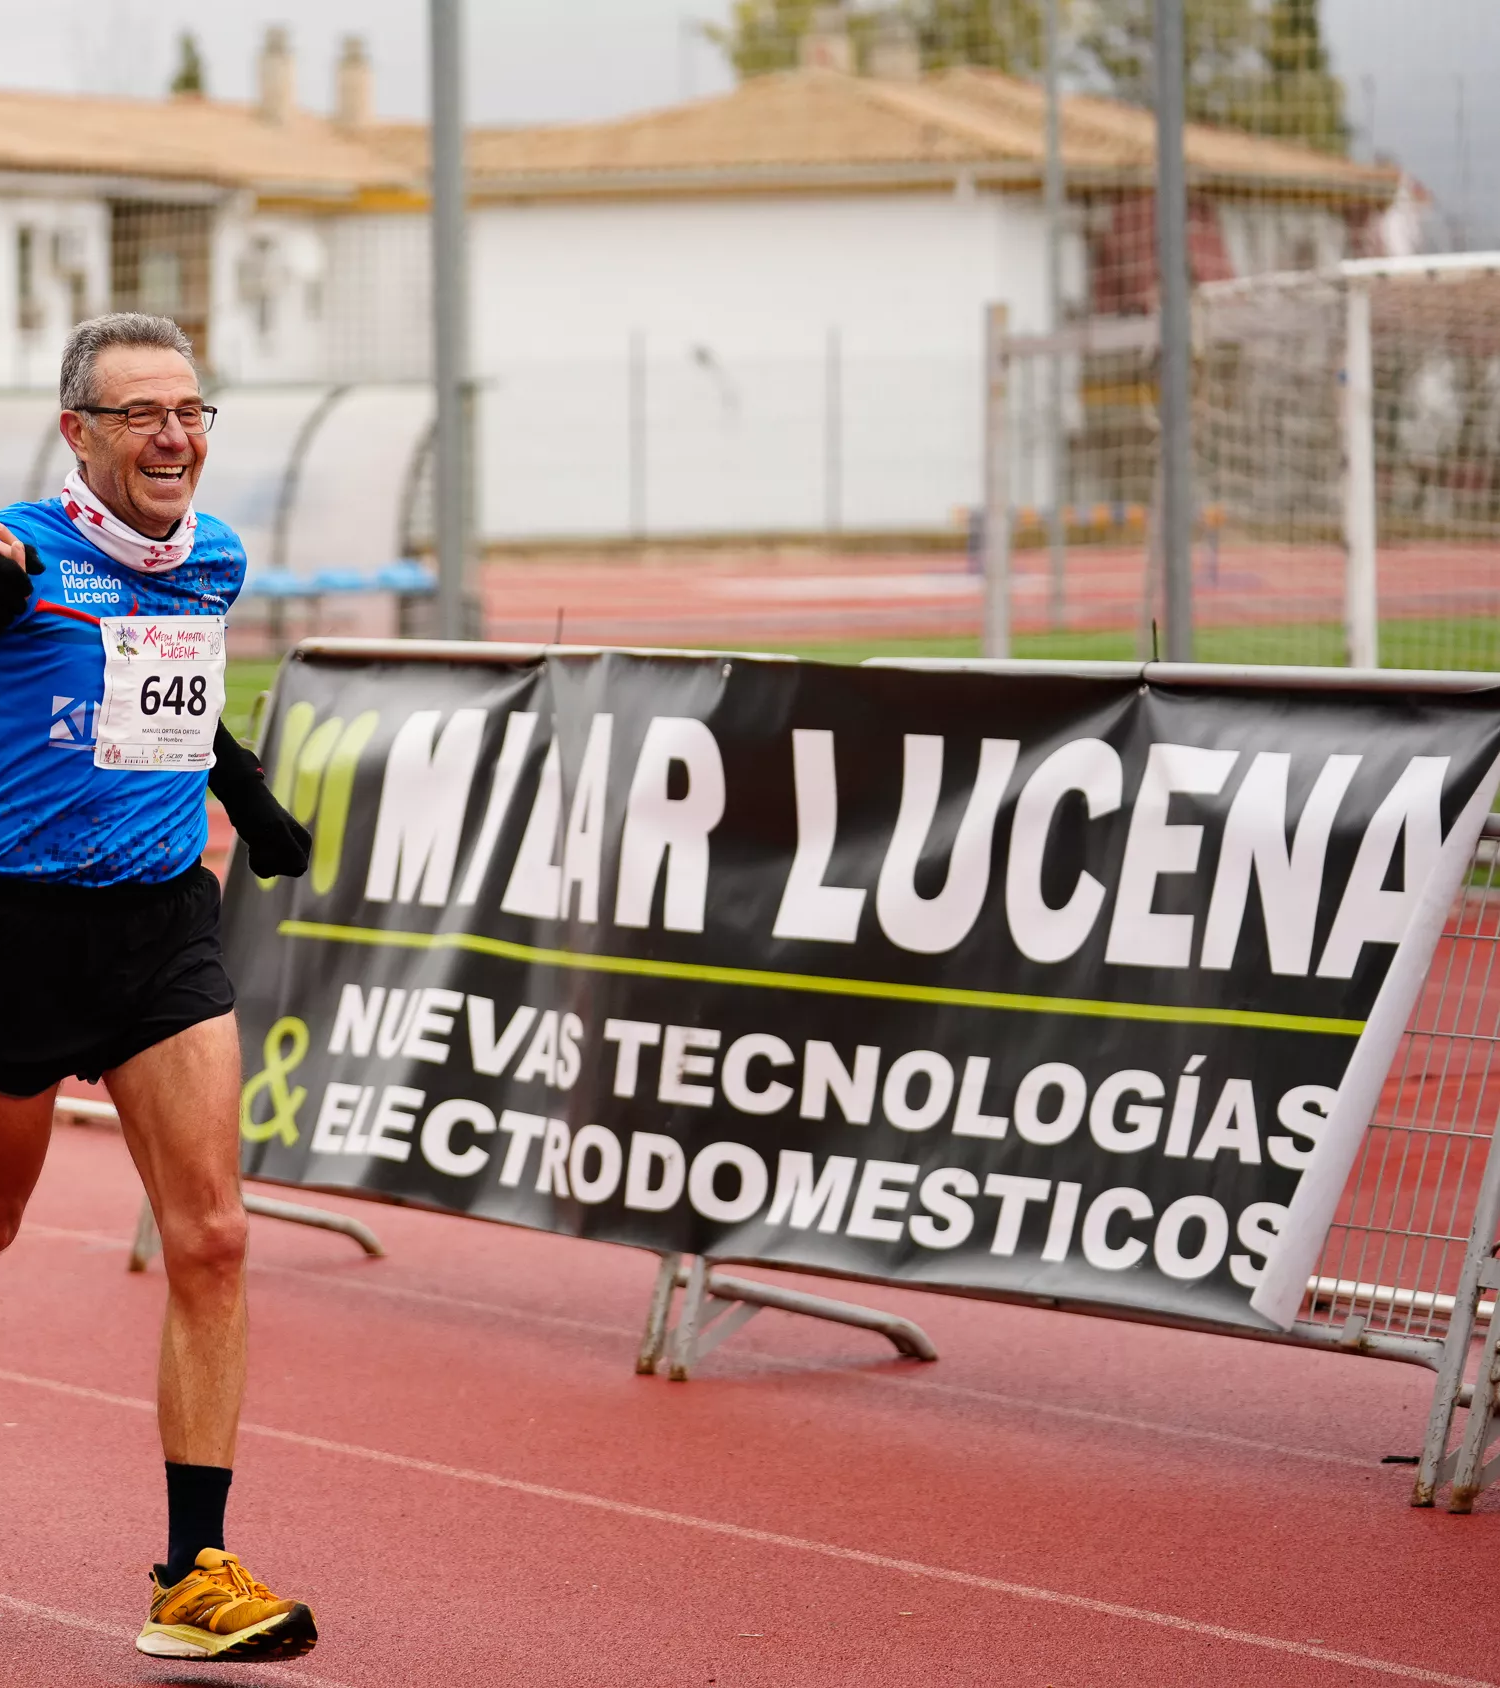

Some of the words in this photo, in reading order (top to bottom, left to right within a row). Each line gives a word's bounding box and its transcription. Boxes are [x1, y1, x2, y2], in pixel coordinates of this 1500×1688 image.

[59, 560, 94, 575] Club
[62, 574, 122, 590] Maratón
[64, 589, 120, 604] Lucena
[160, 643, 200, 660] LUCENA
[140, 675, 207, 716] 648
[364, 707, 726, 933] MILAR
[772, 728, 1452, 979] LUCENA
[241, 1015, 311, 1147] &
[327, 983, 584, 1090] NUEVAS
[603, 1018, 1340, 1170] TECNOLOGÍAS
[310, 1082, 1296, 1290] ELECTRODOMESTICOS
